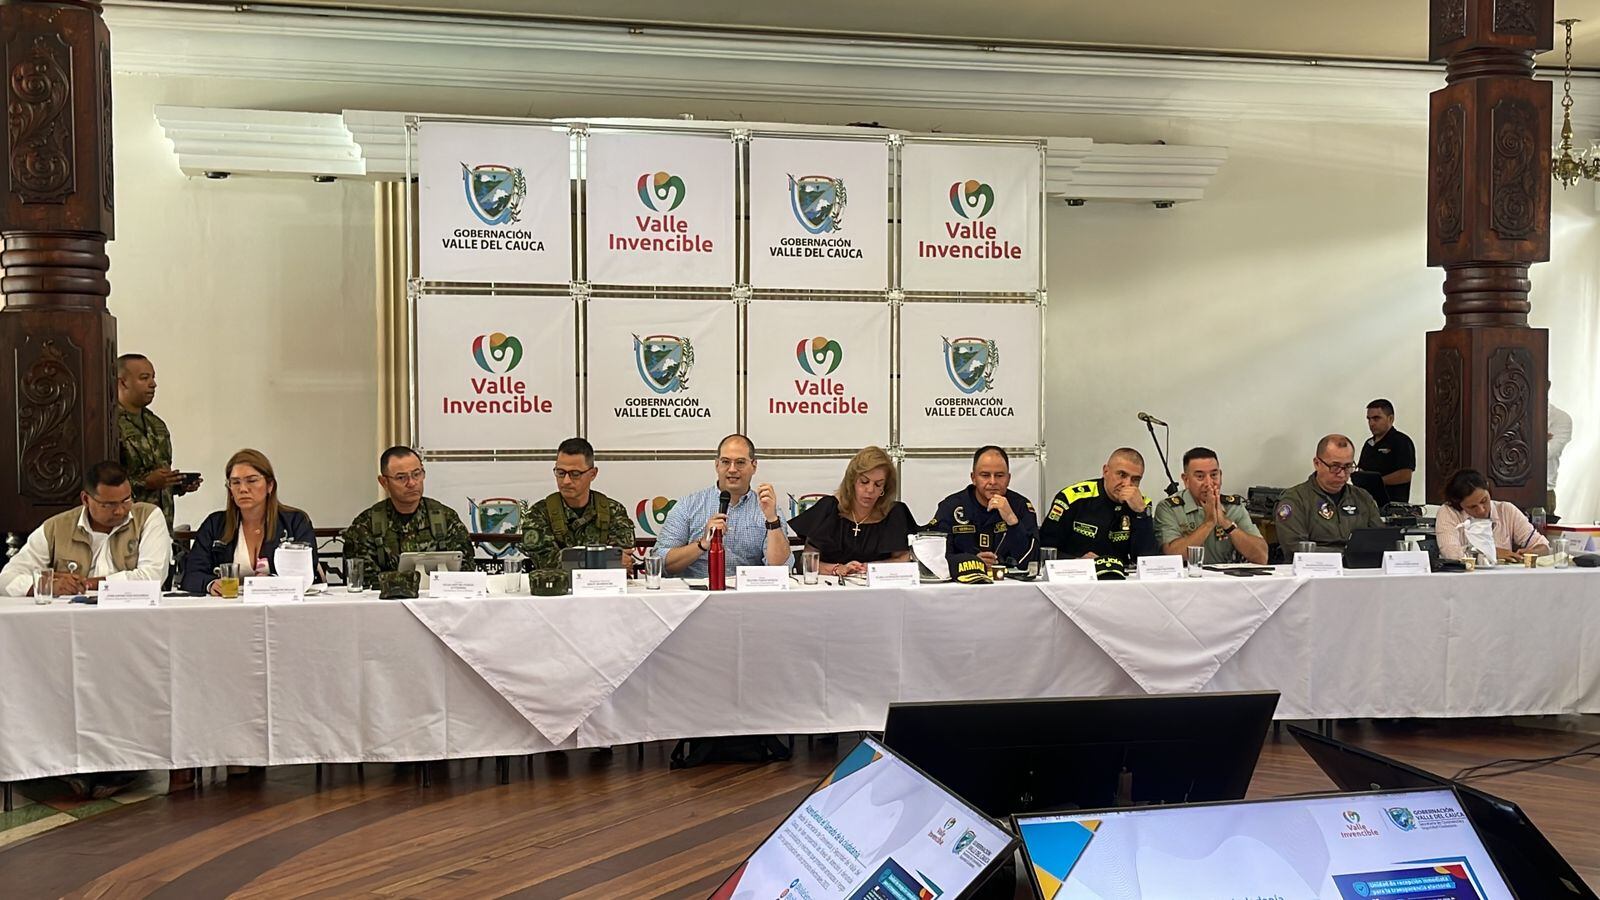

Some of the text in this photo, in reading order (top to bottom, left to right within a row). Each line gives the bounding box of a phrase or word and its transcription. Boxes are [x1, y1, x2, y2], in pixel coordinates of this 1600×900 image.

[636, 215, 687, 233] Valle
[946, 221, 996, 239] Valle
[454, 229, 531, 239] GOBERNACIÓN
[442, 239, 544, 251] VALLE DEL CAUCA
[610, 234, 713, 252] Invencible
[781, 238, 851, 247] GOBERNACIÓN
[770, 247, 863, 258] VALLE DEL CAUCA
[920, 241, 1021, 259] Invencible
[471, 376, 525, 394] Valle
[795, 378, 844, 395] Valle
[444, 395, 552, 413] Invencible
[625, 397, 698, 406] GOBERNACIÓN
[770, 397, 868, 414] Invencible
[935, 397, 1003, 406] GOBERNACIÓN
[614, 408, 711, 417] VALLE DEL CAUCA
[925, 407, 1014, 416] VALLE DEL CAUCA
